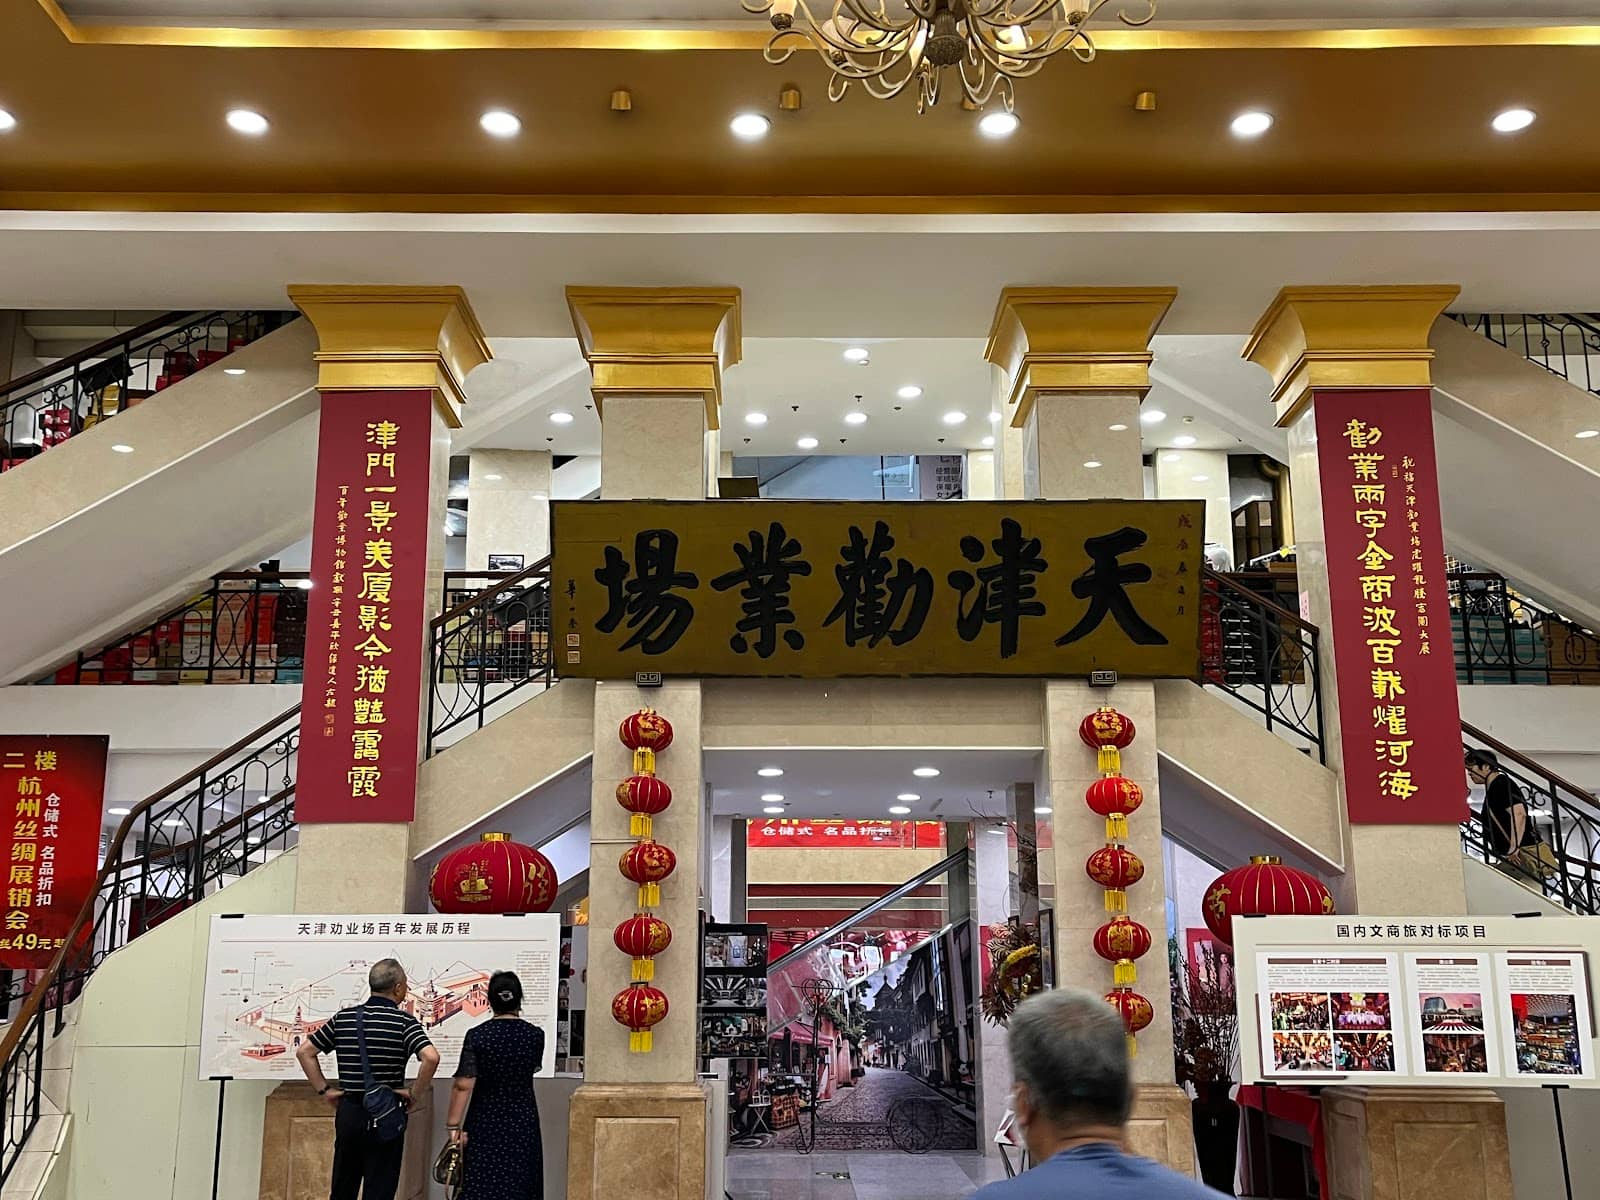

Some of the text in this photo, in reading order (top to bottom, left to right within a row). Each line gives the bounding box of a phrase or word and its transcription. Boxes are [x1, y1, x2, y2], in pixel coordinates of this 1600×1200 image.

[3, 750, 58, 771] 二楼
[761, 826, 813, 836] 仓储式
[5, 776, 43, 930] 杭州丝绸展销会
[36, 792, 61, 907] 仓储式 名品折扣
[298, 922, 472, 936] 天津劝业场百年发展历程
[1336, 924, 1487, 938] 国内文商旅对标项目
